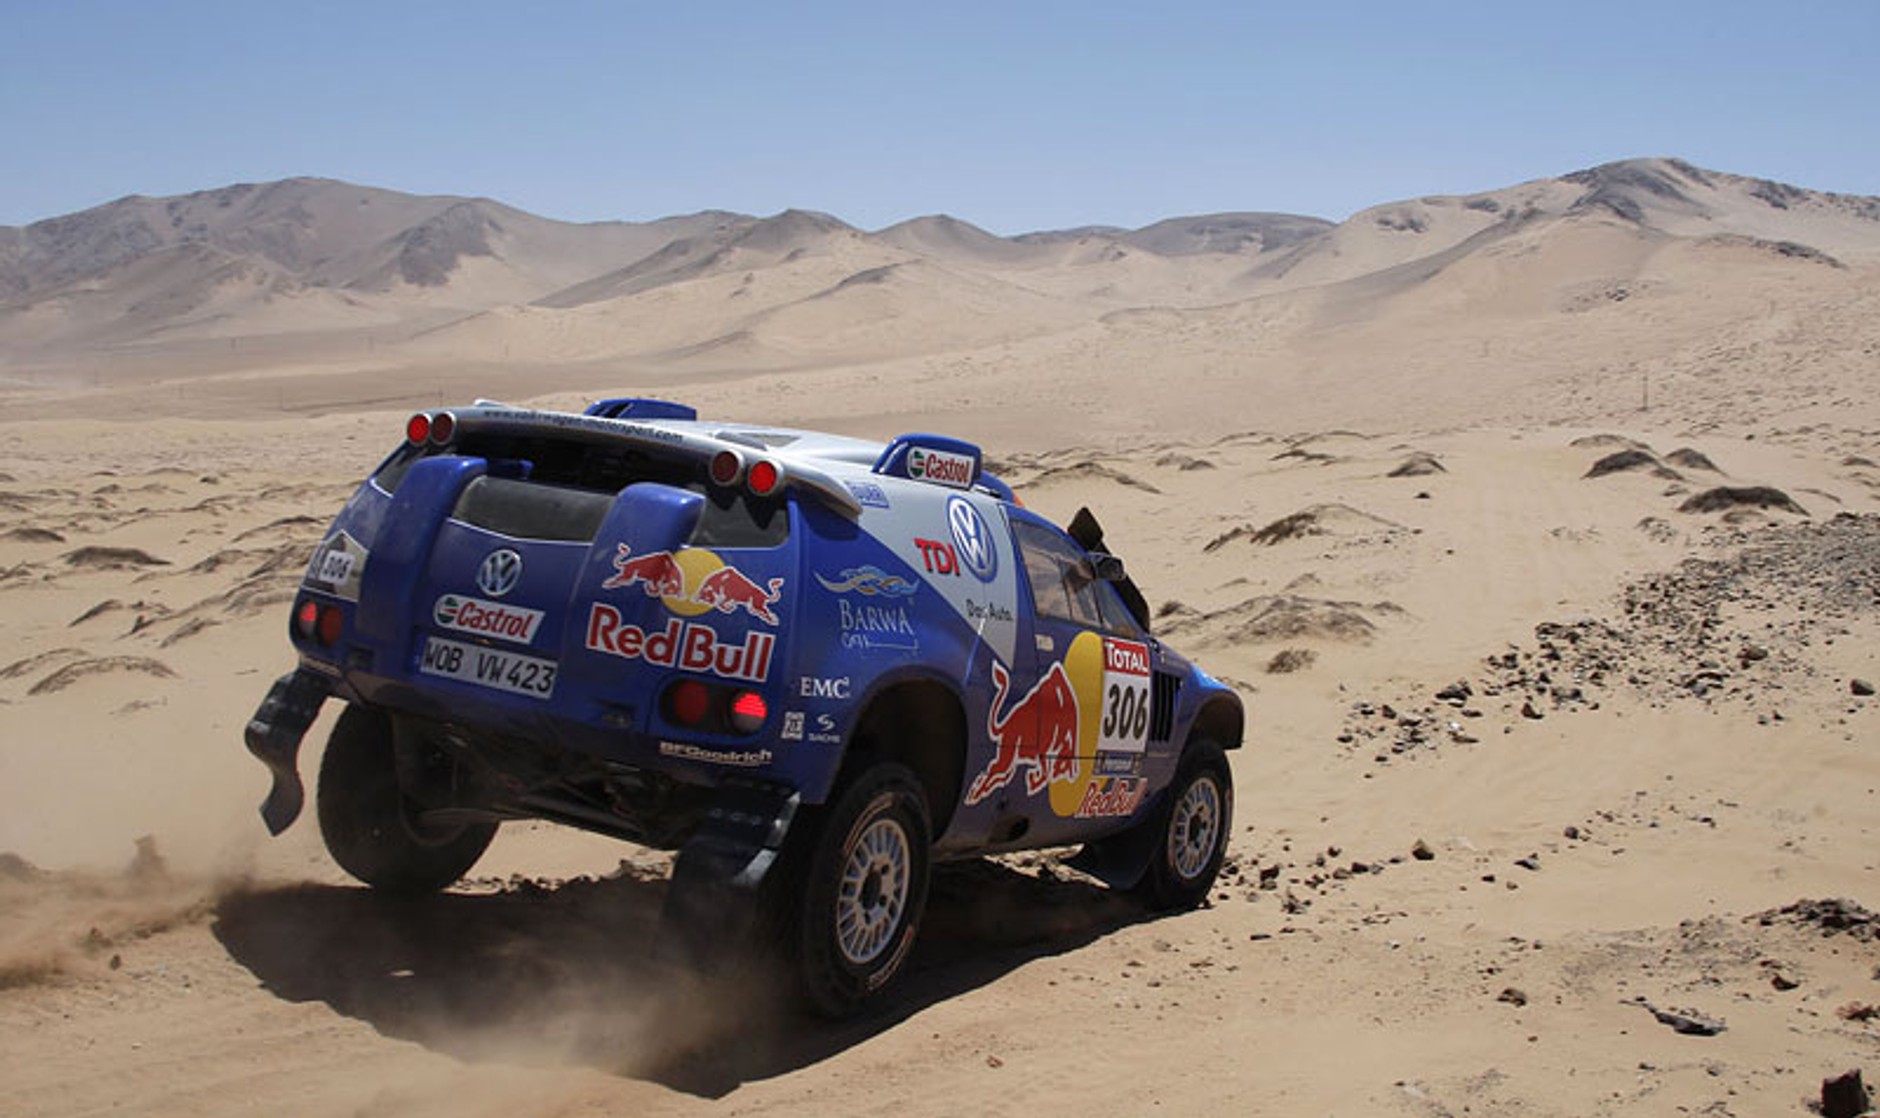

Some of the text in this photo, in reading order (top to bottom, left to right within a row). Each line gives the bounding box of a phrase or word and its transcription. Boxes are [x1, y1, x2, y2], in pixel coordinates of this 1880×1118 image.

[925, 453, 970, 484] Castrol
[914, 537, 960, 577] TDI
[456, 602, 534, 639] Castrol
[838, 599, 915, 635] BARWA
[424, 641, 556, 693] WOB VW 423
[1104, 642, 1149, 671] TOTAL
[1103, 683, 1148, 740] 306
